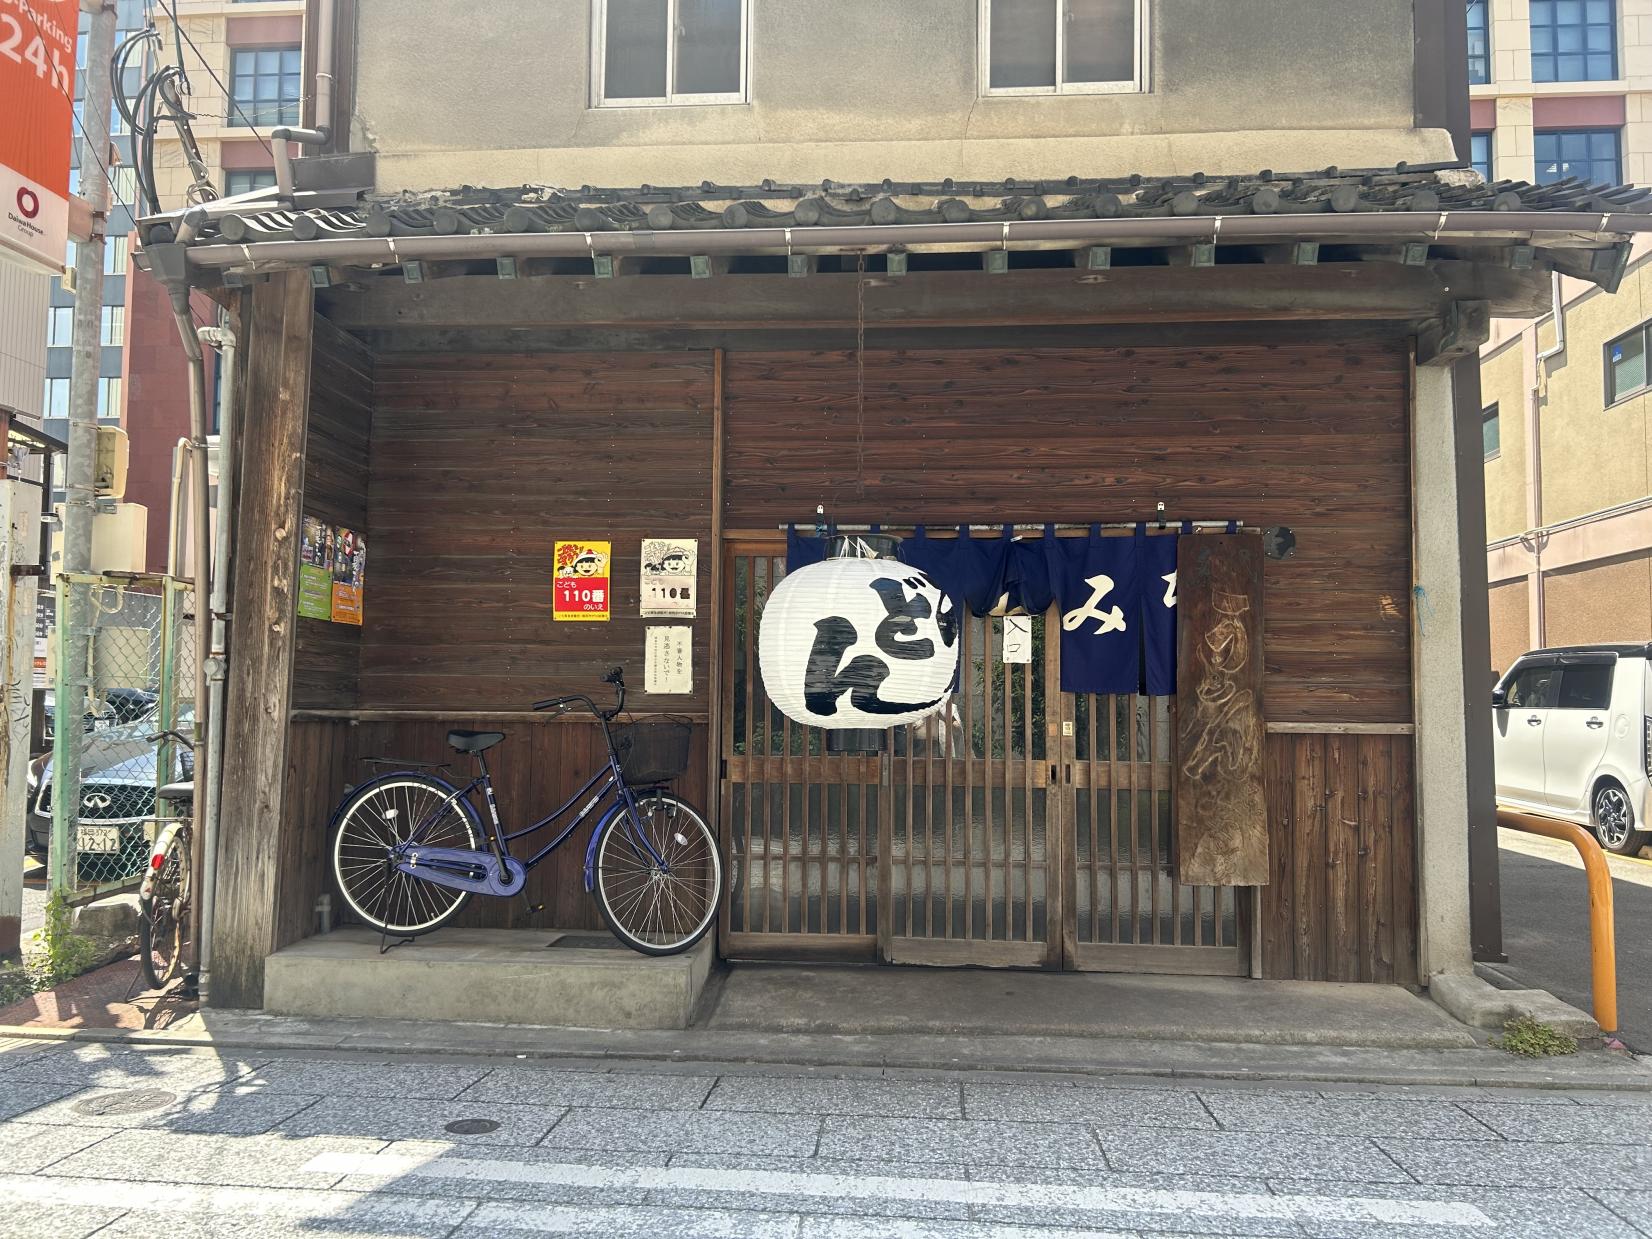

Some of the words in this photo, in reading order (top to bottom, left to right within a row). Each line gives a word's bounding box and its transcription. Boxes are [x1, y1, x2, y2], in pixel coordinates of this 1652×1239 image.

[0, 13, 69, 96] 24h
[17, 224, 34, 238] Group
[563, 589, 605, 603] 110番
[583, 603, 605, 611] のいえ
[1007, 618, 1029, 653] 入口
